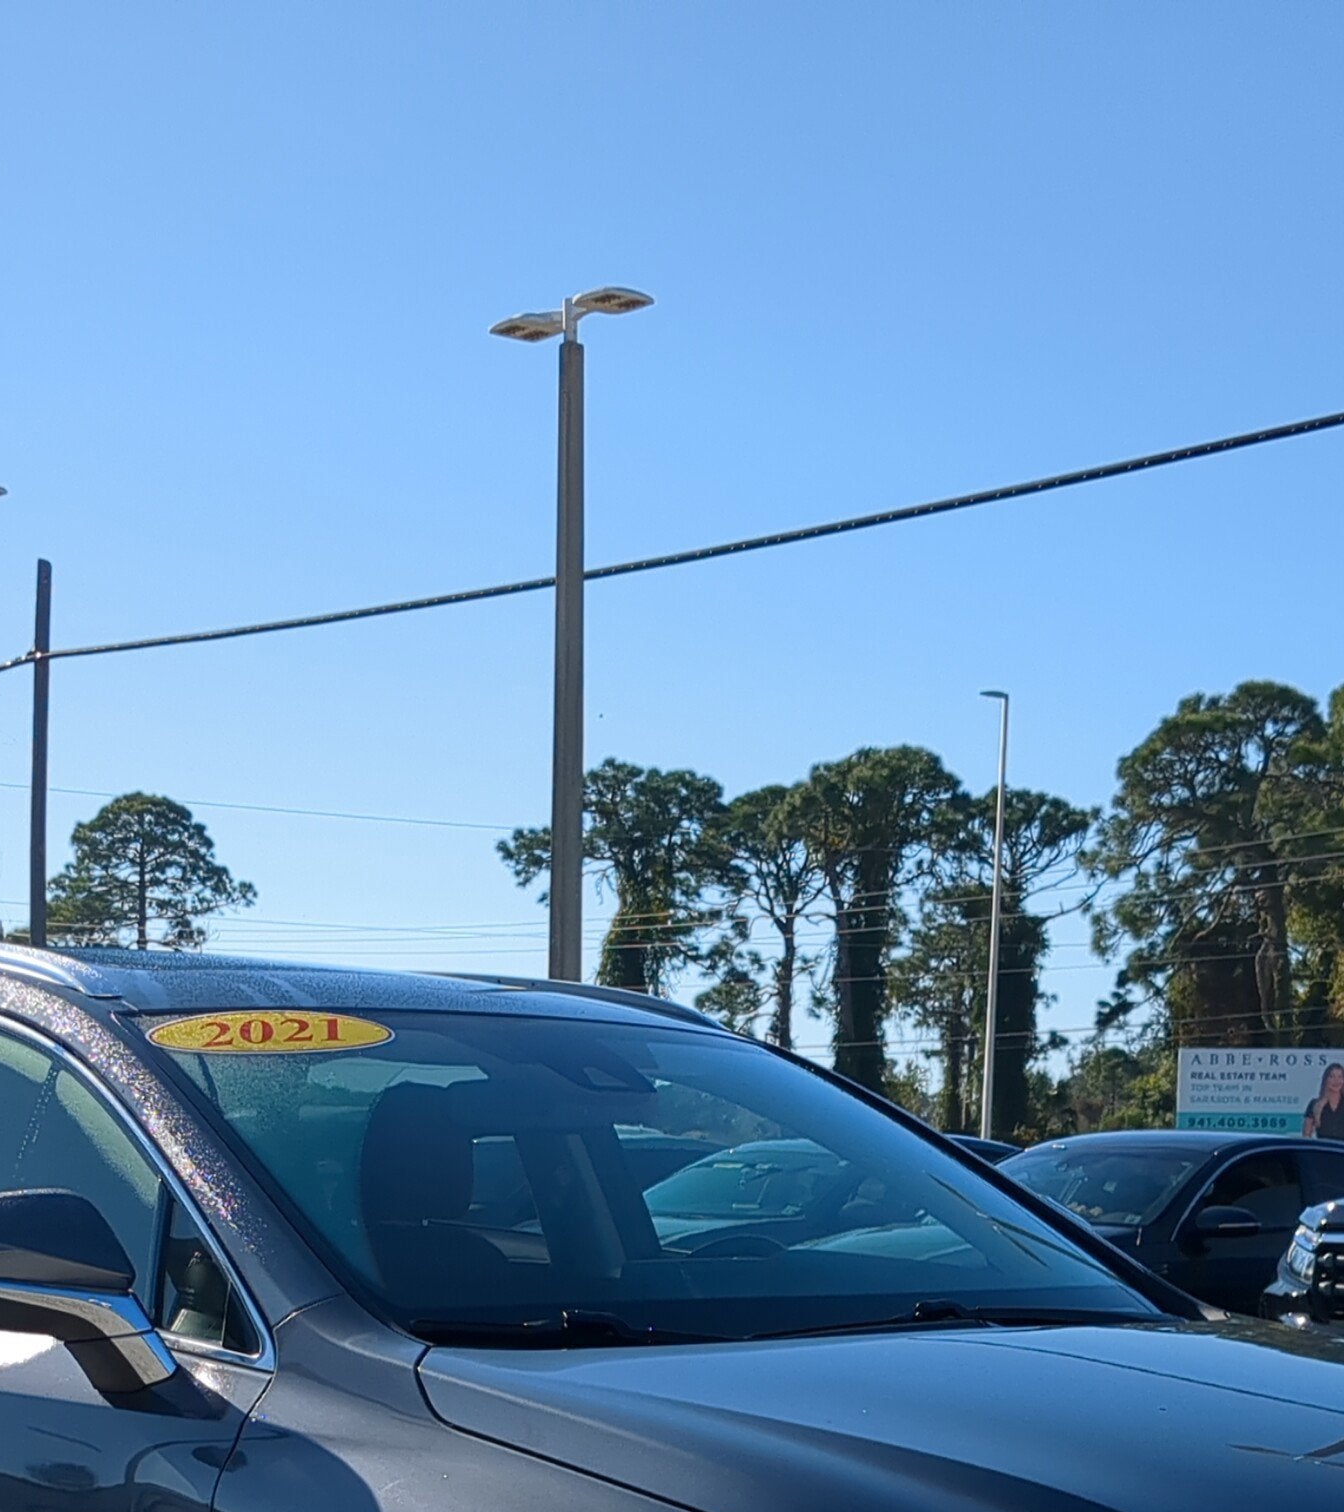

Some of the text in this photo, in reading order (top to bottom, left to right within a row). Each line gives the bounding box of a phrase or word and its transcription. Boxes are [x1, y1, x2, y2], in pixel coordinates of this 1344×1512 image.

[200, 1017, 347, 1048] 2021
[1190, 1053, 1328, 1066] ABBE ROSS
[1190, 1071, 1287, 1081] REAL ESTATE TEAM
